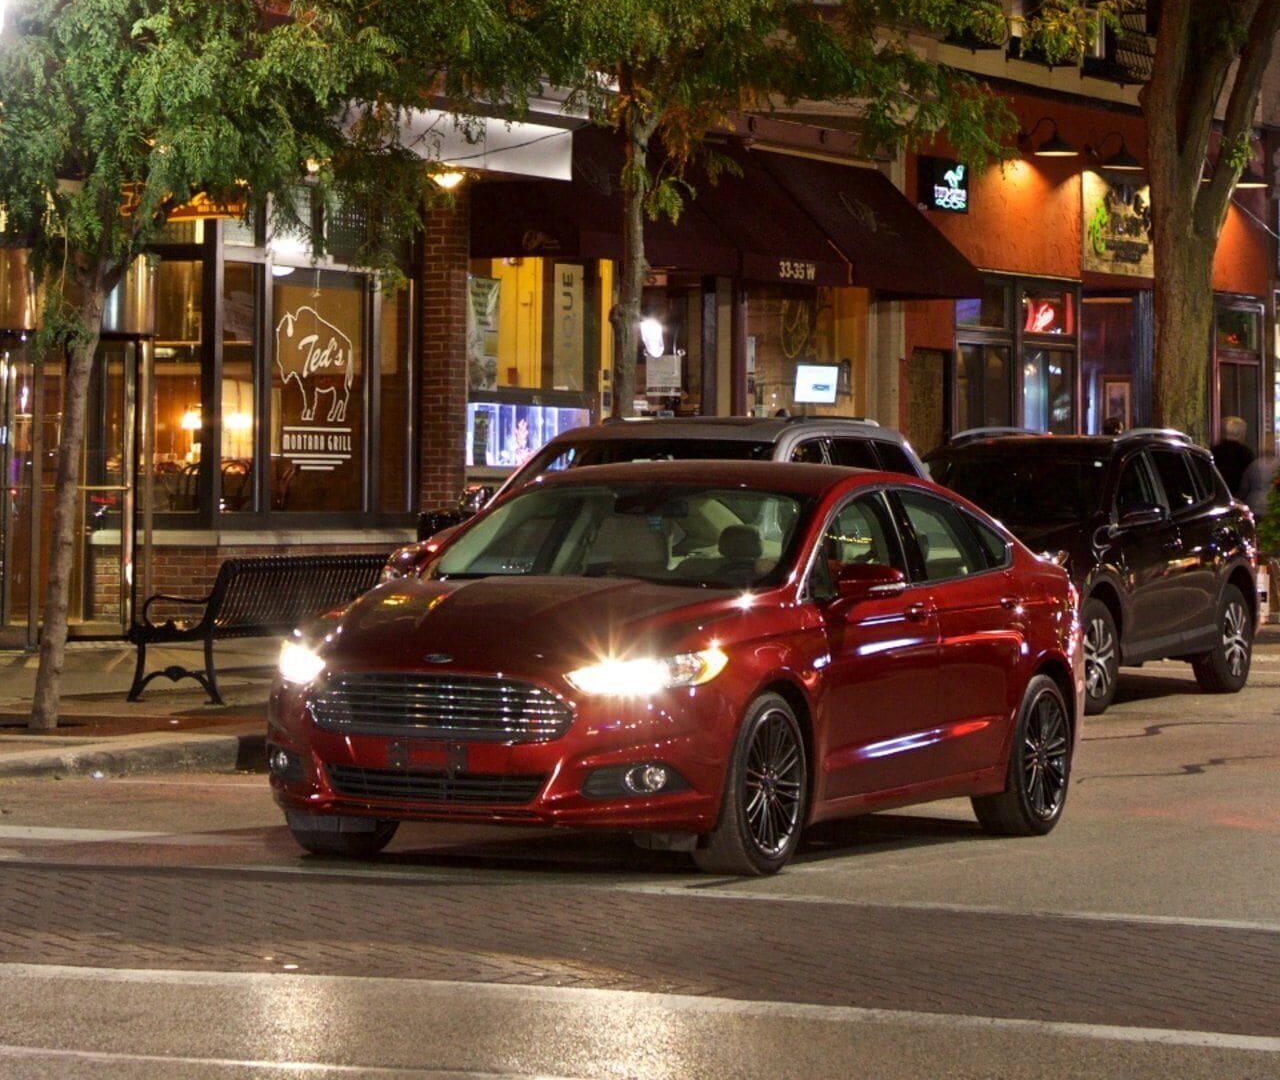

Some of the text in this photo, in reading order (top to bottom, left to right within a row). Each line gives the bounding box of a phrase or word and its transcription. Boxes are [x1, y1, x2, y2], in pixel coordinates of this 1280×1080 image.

[298, 334, 345, 378] Ted's
[283, 434, 352, 451] MONTANA GRILL
